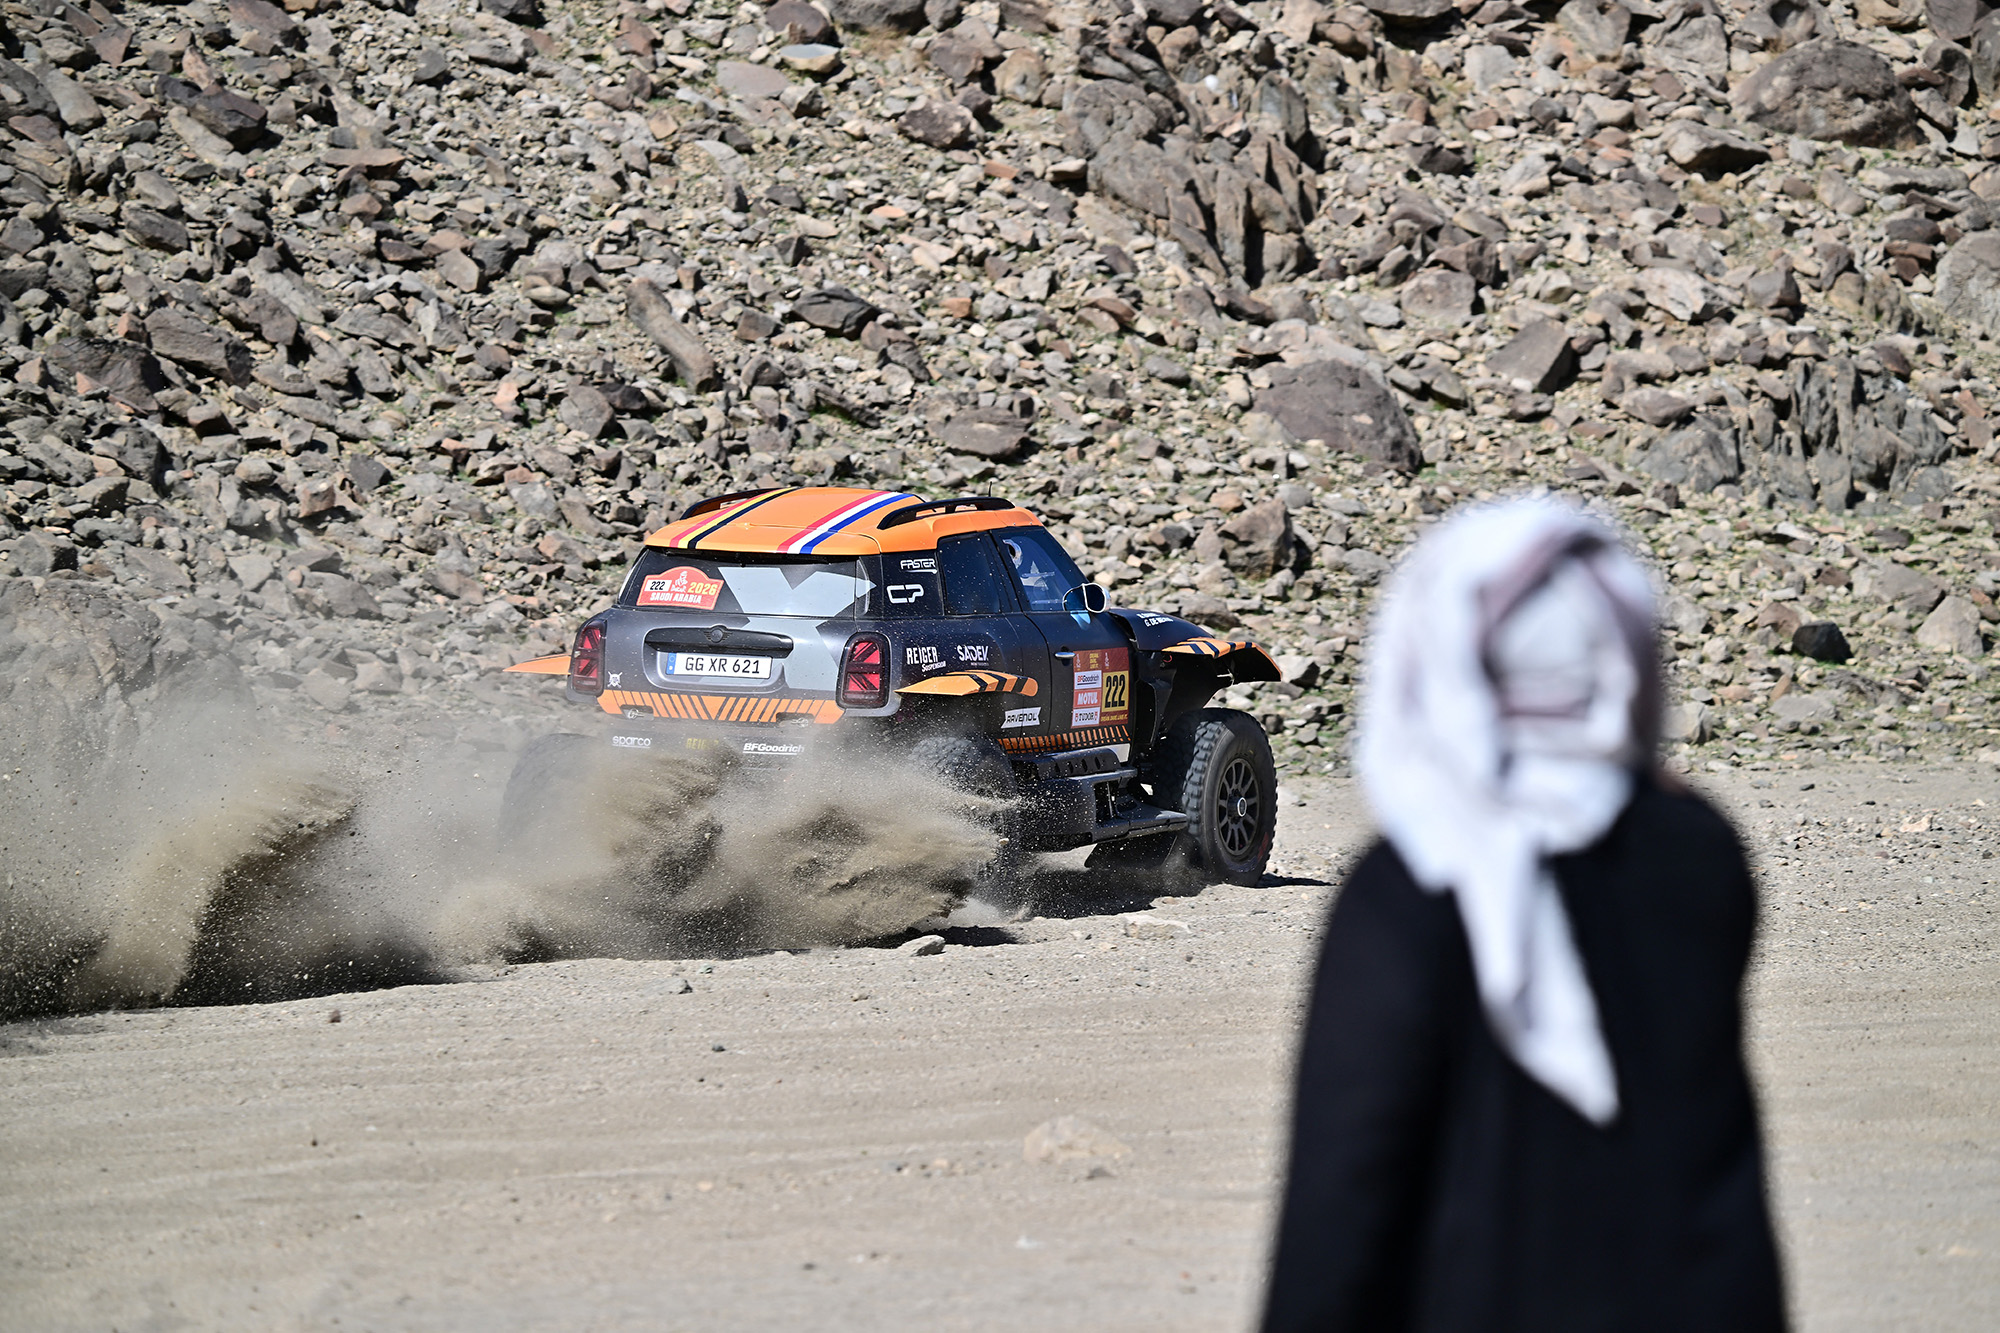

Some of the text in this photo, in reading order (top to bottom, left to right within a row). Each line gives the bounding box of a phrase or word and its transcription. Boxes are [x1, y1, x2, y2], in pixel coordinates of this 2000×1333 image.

[900, 558, 936, 569] FASTER
[649, 581, 718, 596] 222 2026
[650, 592, 703, 604] SAUDI ARABIA
[906, 646, 939, 665] REIGER
[956, 645, 989, 661] SADEV
[685, 657, 760, 674] GG XR 621
[1077, 691, 1098, 705] MOTUL
[1104, 674, 1126, 708] 222
[612, 735, 651, 747] sparco
[742, 742, 804, 754] BFGoodrich
